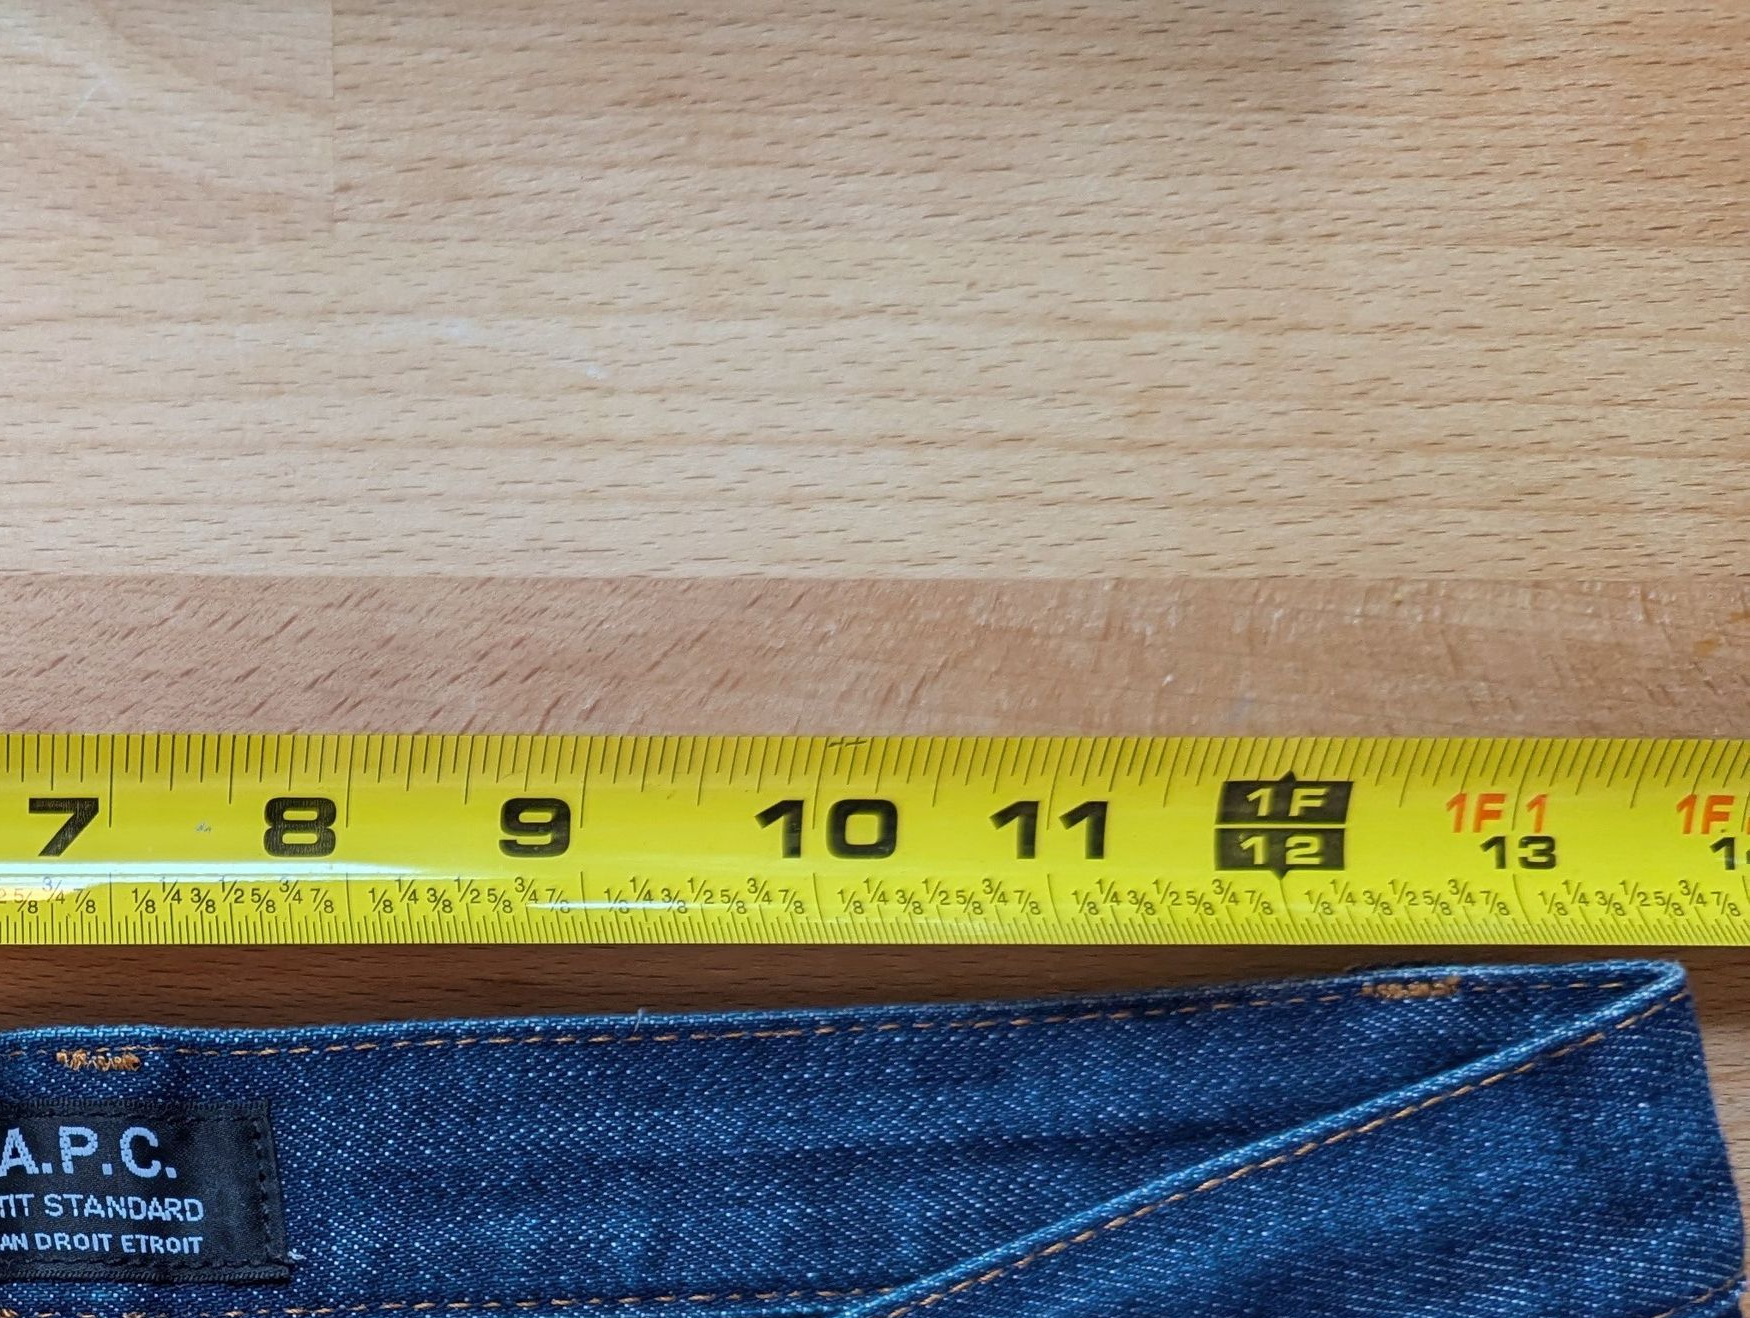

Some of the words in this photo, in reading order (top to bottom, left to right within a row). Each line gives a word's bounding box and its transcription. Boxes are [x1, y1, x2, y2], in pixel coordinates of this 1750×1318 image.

[1246, 788, 1329, 816] 1F
[28, 797, 99, 857] 7
[262, 797, 337, 858] 8
[498, 797, 572, 858] 9
[755, 798, 898, 859] 10
[989, 800, 1108, 860] 11
[1240, 836, 1322, 865] 12
[1480, 835, 1556, 869] 13
[1709, 836, 1750, 870] 1
[44, 1194, 205, 1222] STANDARD
[36, 1233, 112, 1252] DROIT
[122, 1234, 203, 1254] ETROIT
